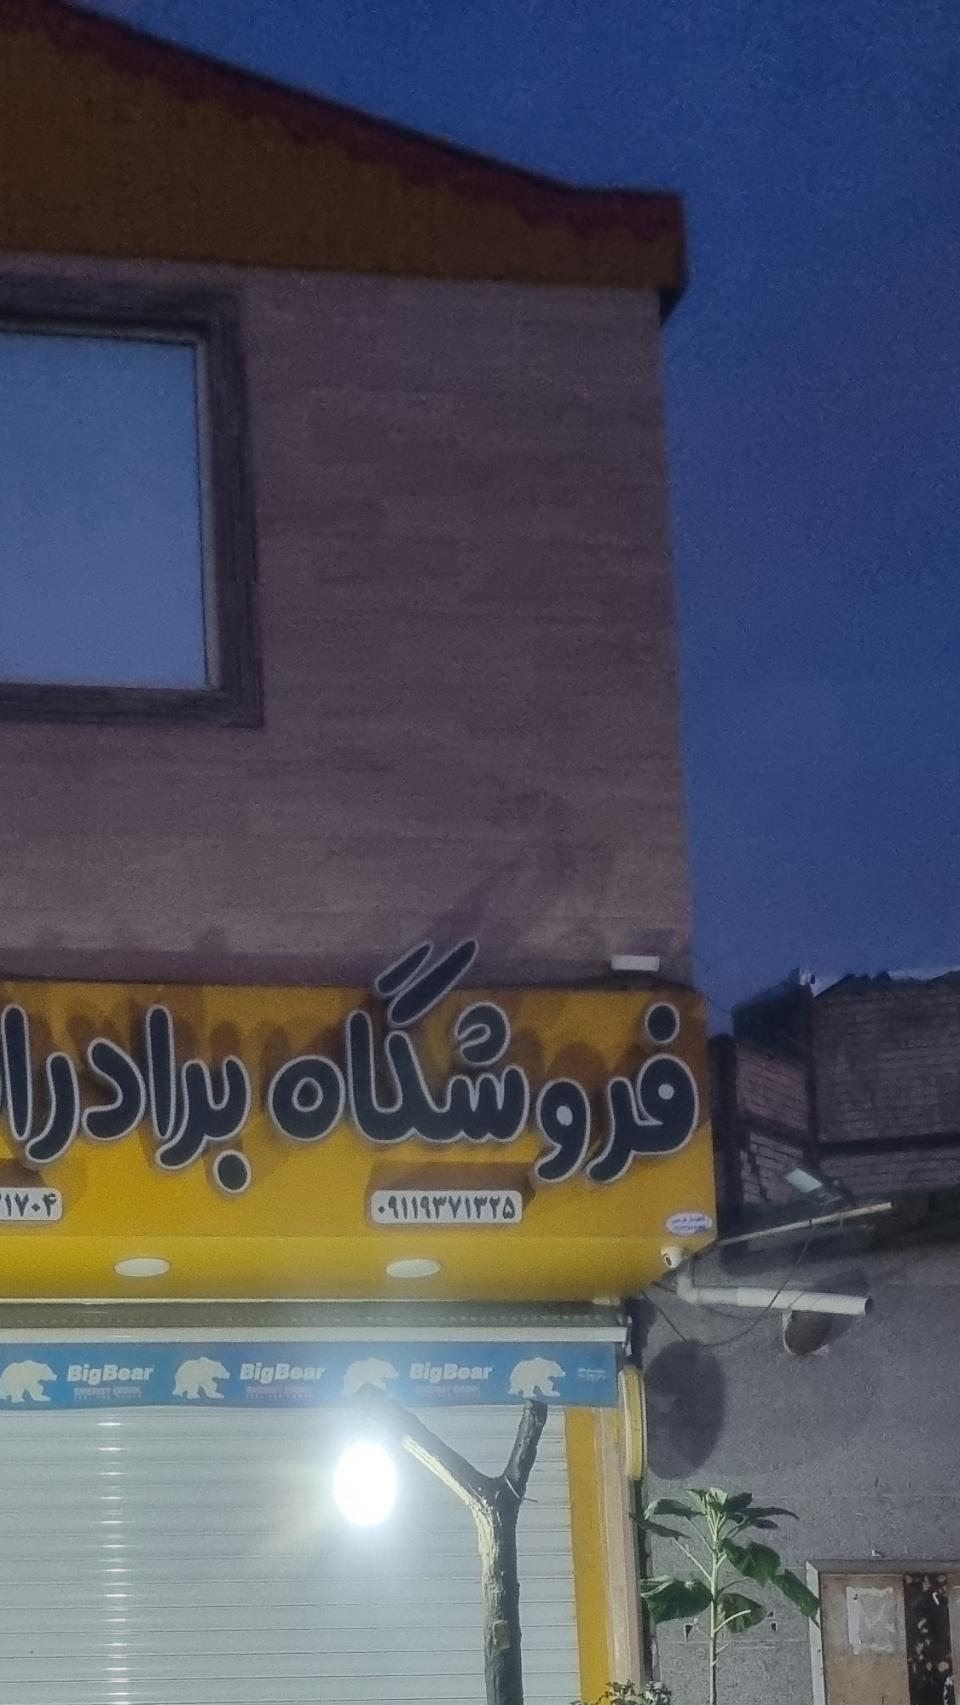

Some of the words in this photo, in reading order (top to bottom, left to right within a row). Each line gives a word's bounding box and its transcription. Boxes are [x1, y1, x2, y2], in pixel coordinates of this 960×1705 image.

[269, 939, 701, 1184] فروشگاه
[378, 1195, 515, 1220] ۰۹۱۱۹۳۷۱۳۲۵
[67, 1364, 154, 1385] BigBear
[240, 1363, 327, 1385] BigBear
[409, 1362, 493, 1384] BigBear
